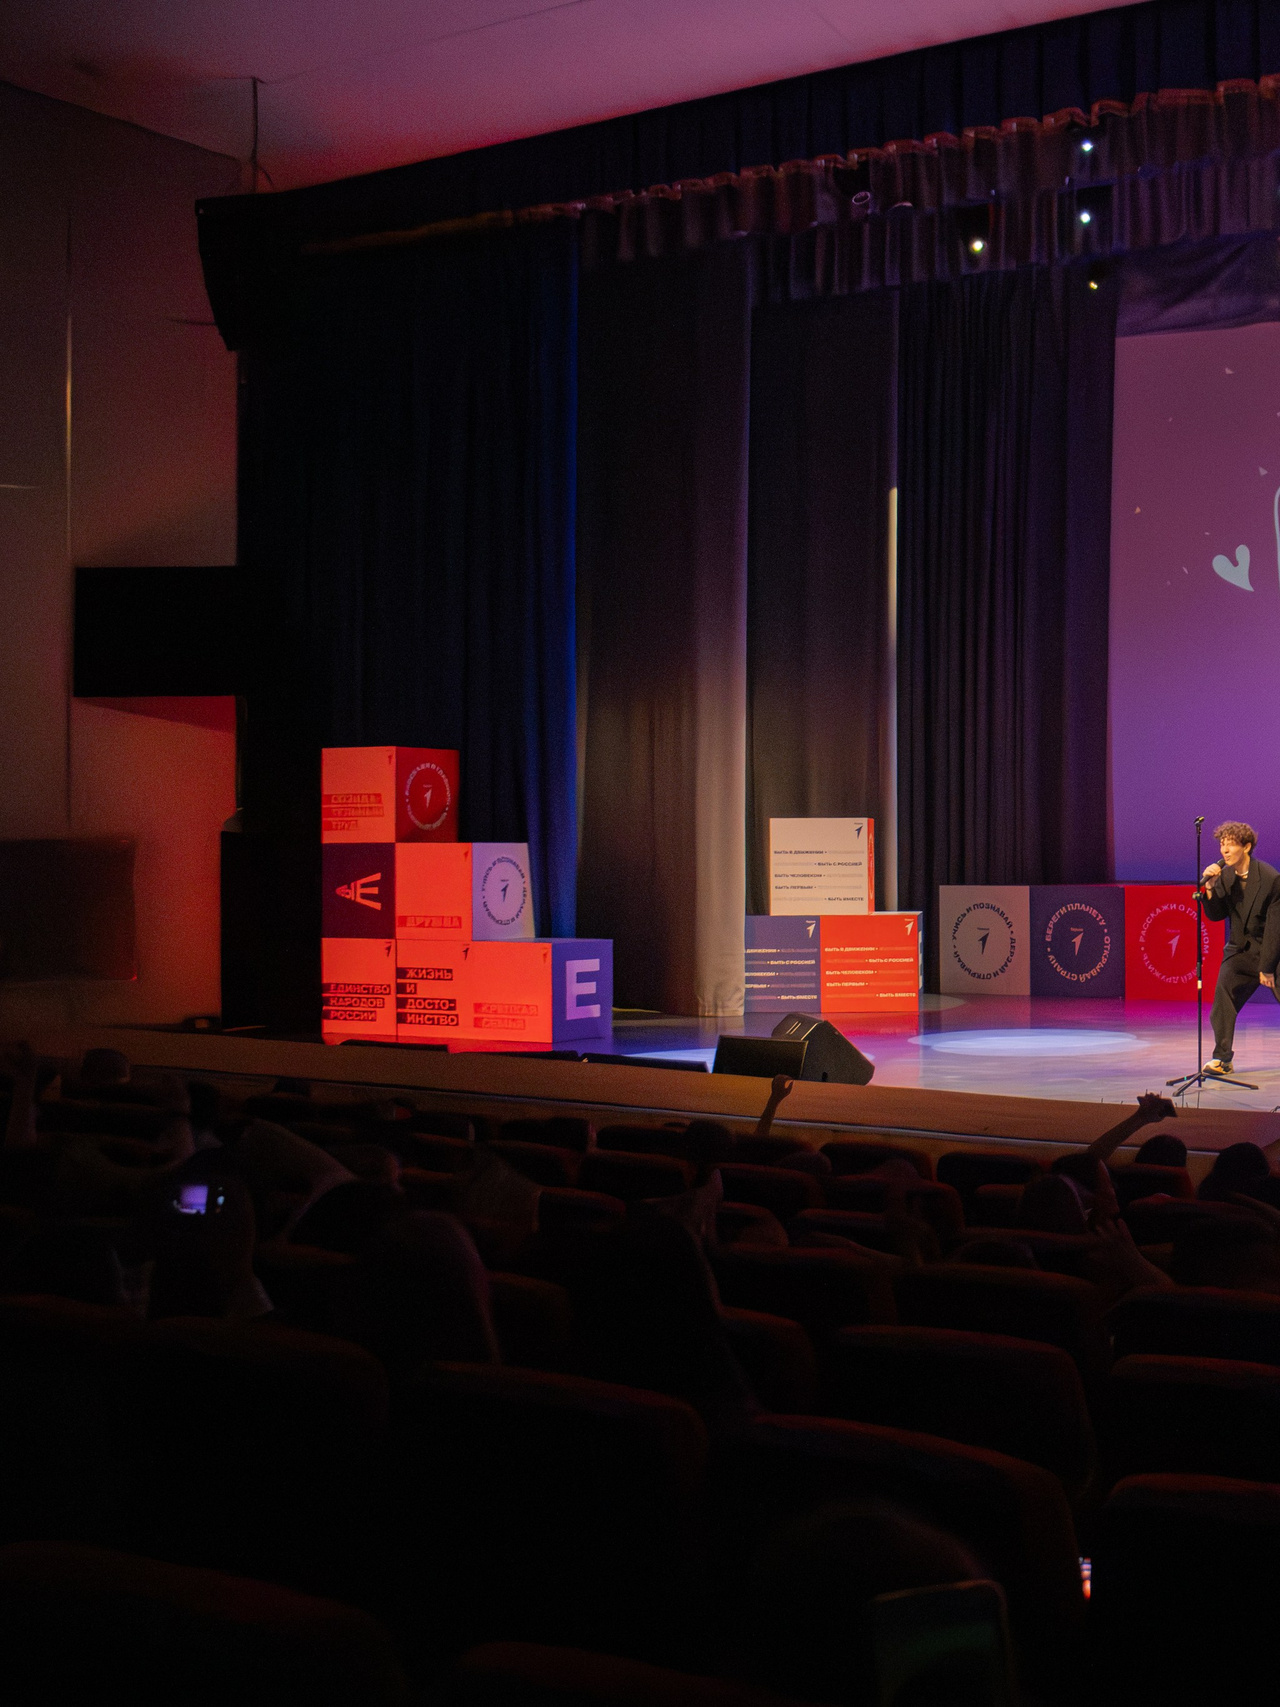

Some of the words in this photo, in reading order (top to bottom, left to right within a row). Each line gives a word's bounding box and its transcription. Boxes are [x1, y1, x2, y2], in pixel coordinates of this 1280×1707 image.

[972, 902, 1014, 929] ПОЗНАВАЙ
[1045, 906, 1068, 942] БЕРЕГИ
[1067, 902, 1106, 926] ПЛАНЕТУ
[1138, 903, 1176, 943] РАССКАЖИ
[1178, 904, 1185, 912] О
[1186, 907, 1210, 954] ГЛВНОМ
[1048, 954, 1078, 981] СТРАНУ
[1079, 935, 1111, 983] ОТКРЫВАЙ
[1142, 953, 1179, 984] ДРУЖИТЬ
[406, 968, 453, 980] ЖИЗНЬ
[330, 984, 390, 995] ЕДИНСТВО
[406, 983, 415, 993] И
[566, 958, 600, 1020] Е
[330, 997, 384, 1008] НАРОДОВ
[406, 999, 455, 1010] ДОСТО-
[330, 1011, 376, 1021] РОССИИ
[406, 1014, 458, 1026] ИНСТВО
